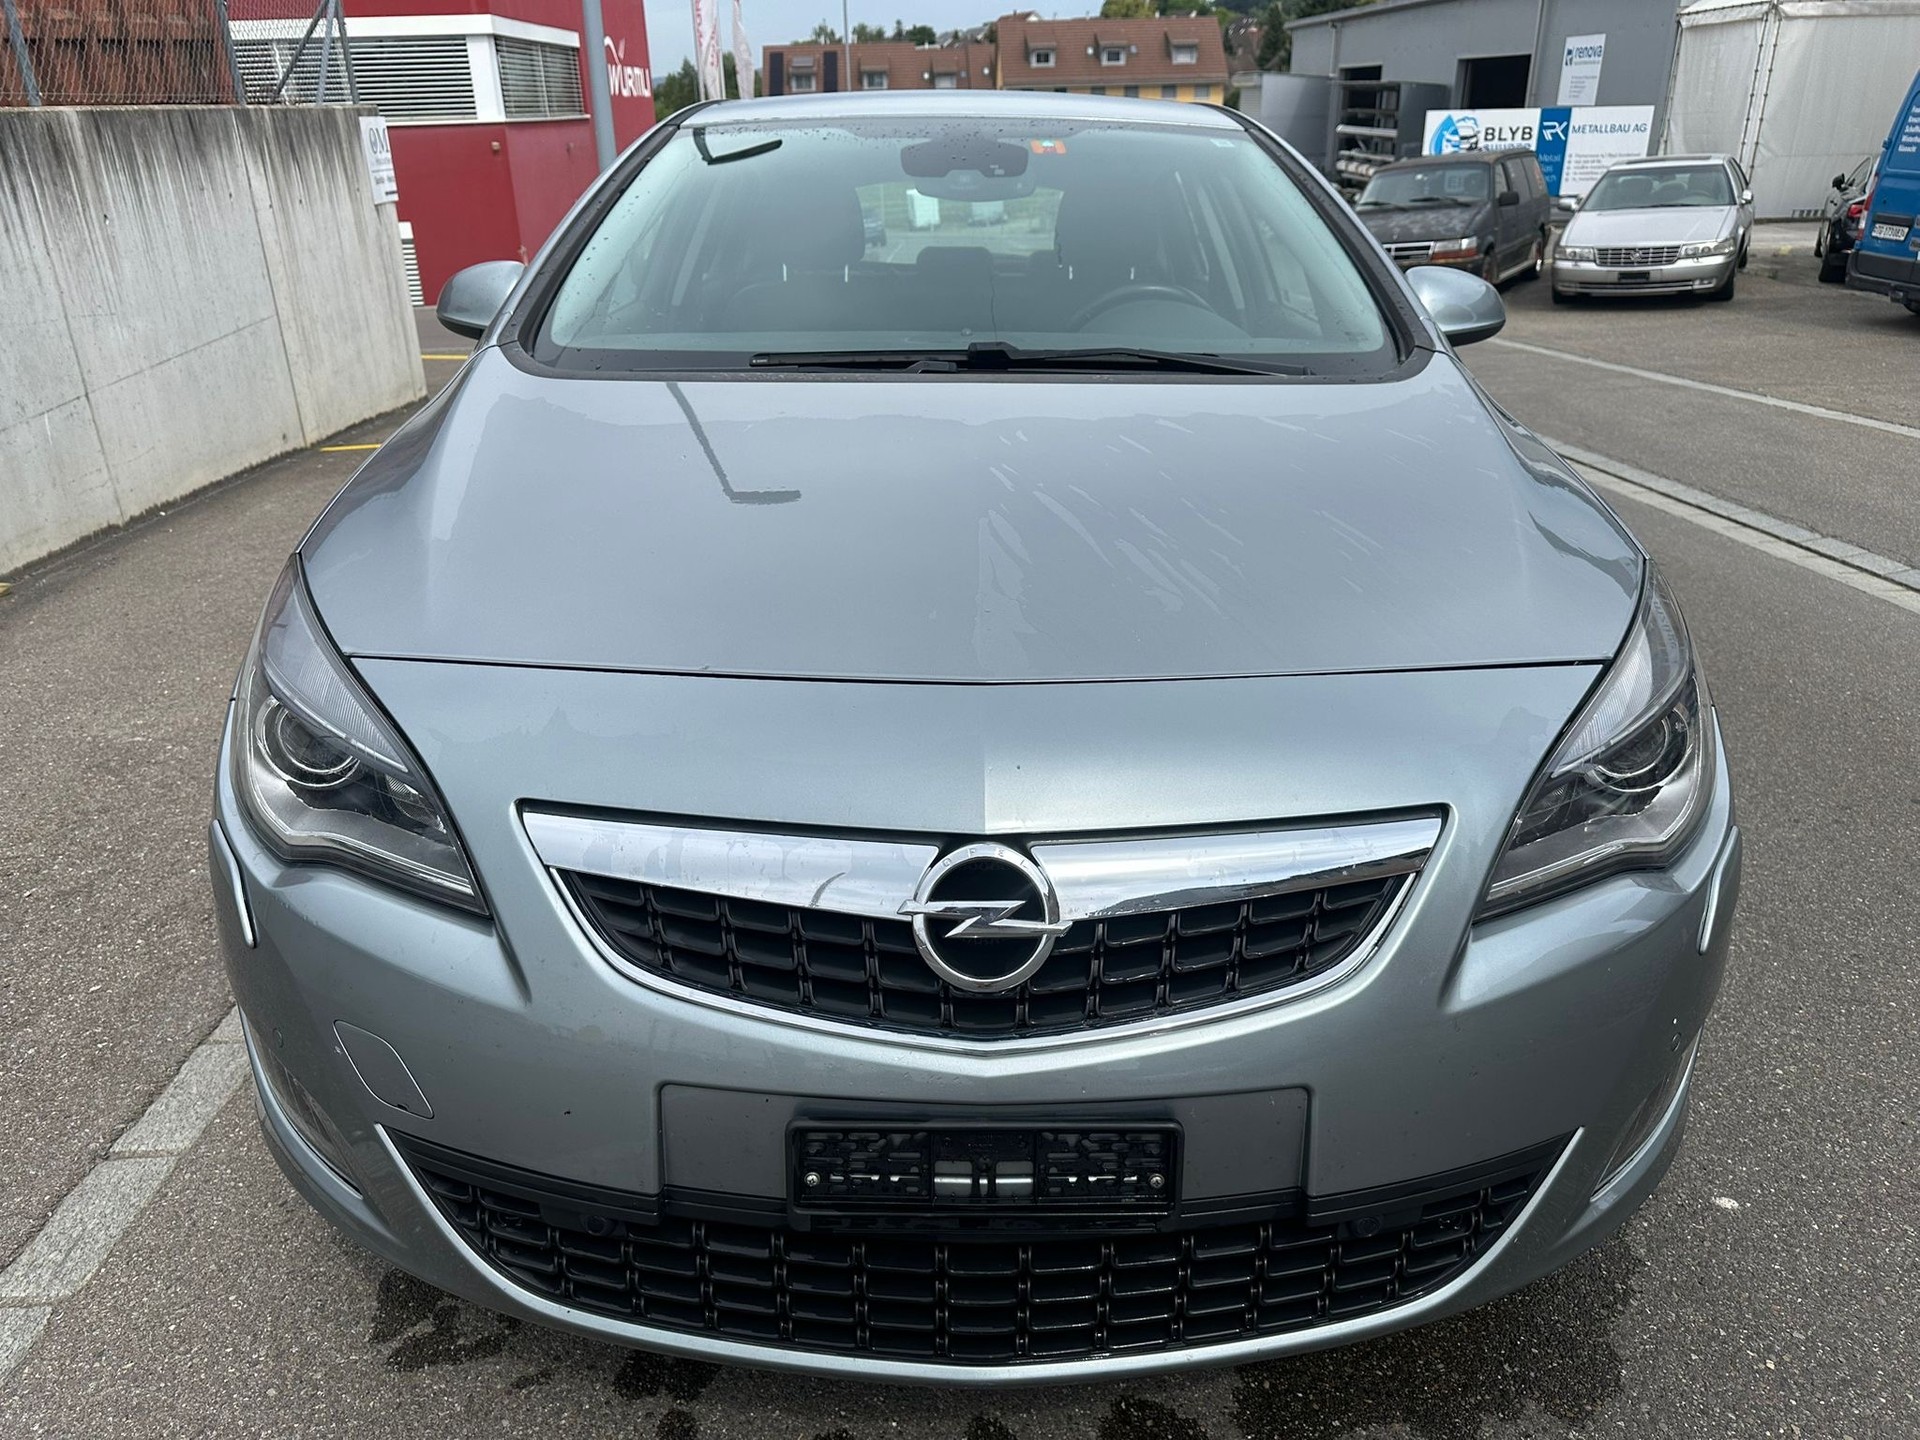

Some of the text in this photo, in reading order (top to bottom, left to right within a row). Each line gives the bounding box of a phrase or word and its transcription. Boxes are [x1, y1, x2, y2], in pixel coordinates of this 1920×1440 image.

[1574, 45, 1603, 58] renova
[1484, 126, 1533, 141] BLYB
[1571, 123, 1648, 134] METALLBAU AG
[943, 848, 1028, 868] OPEL
